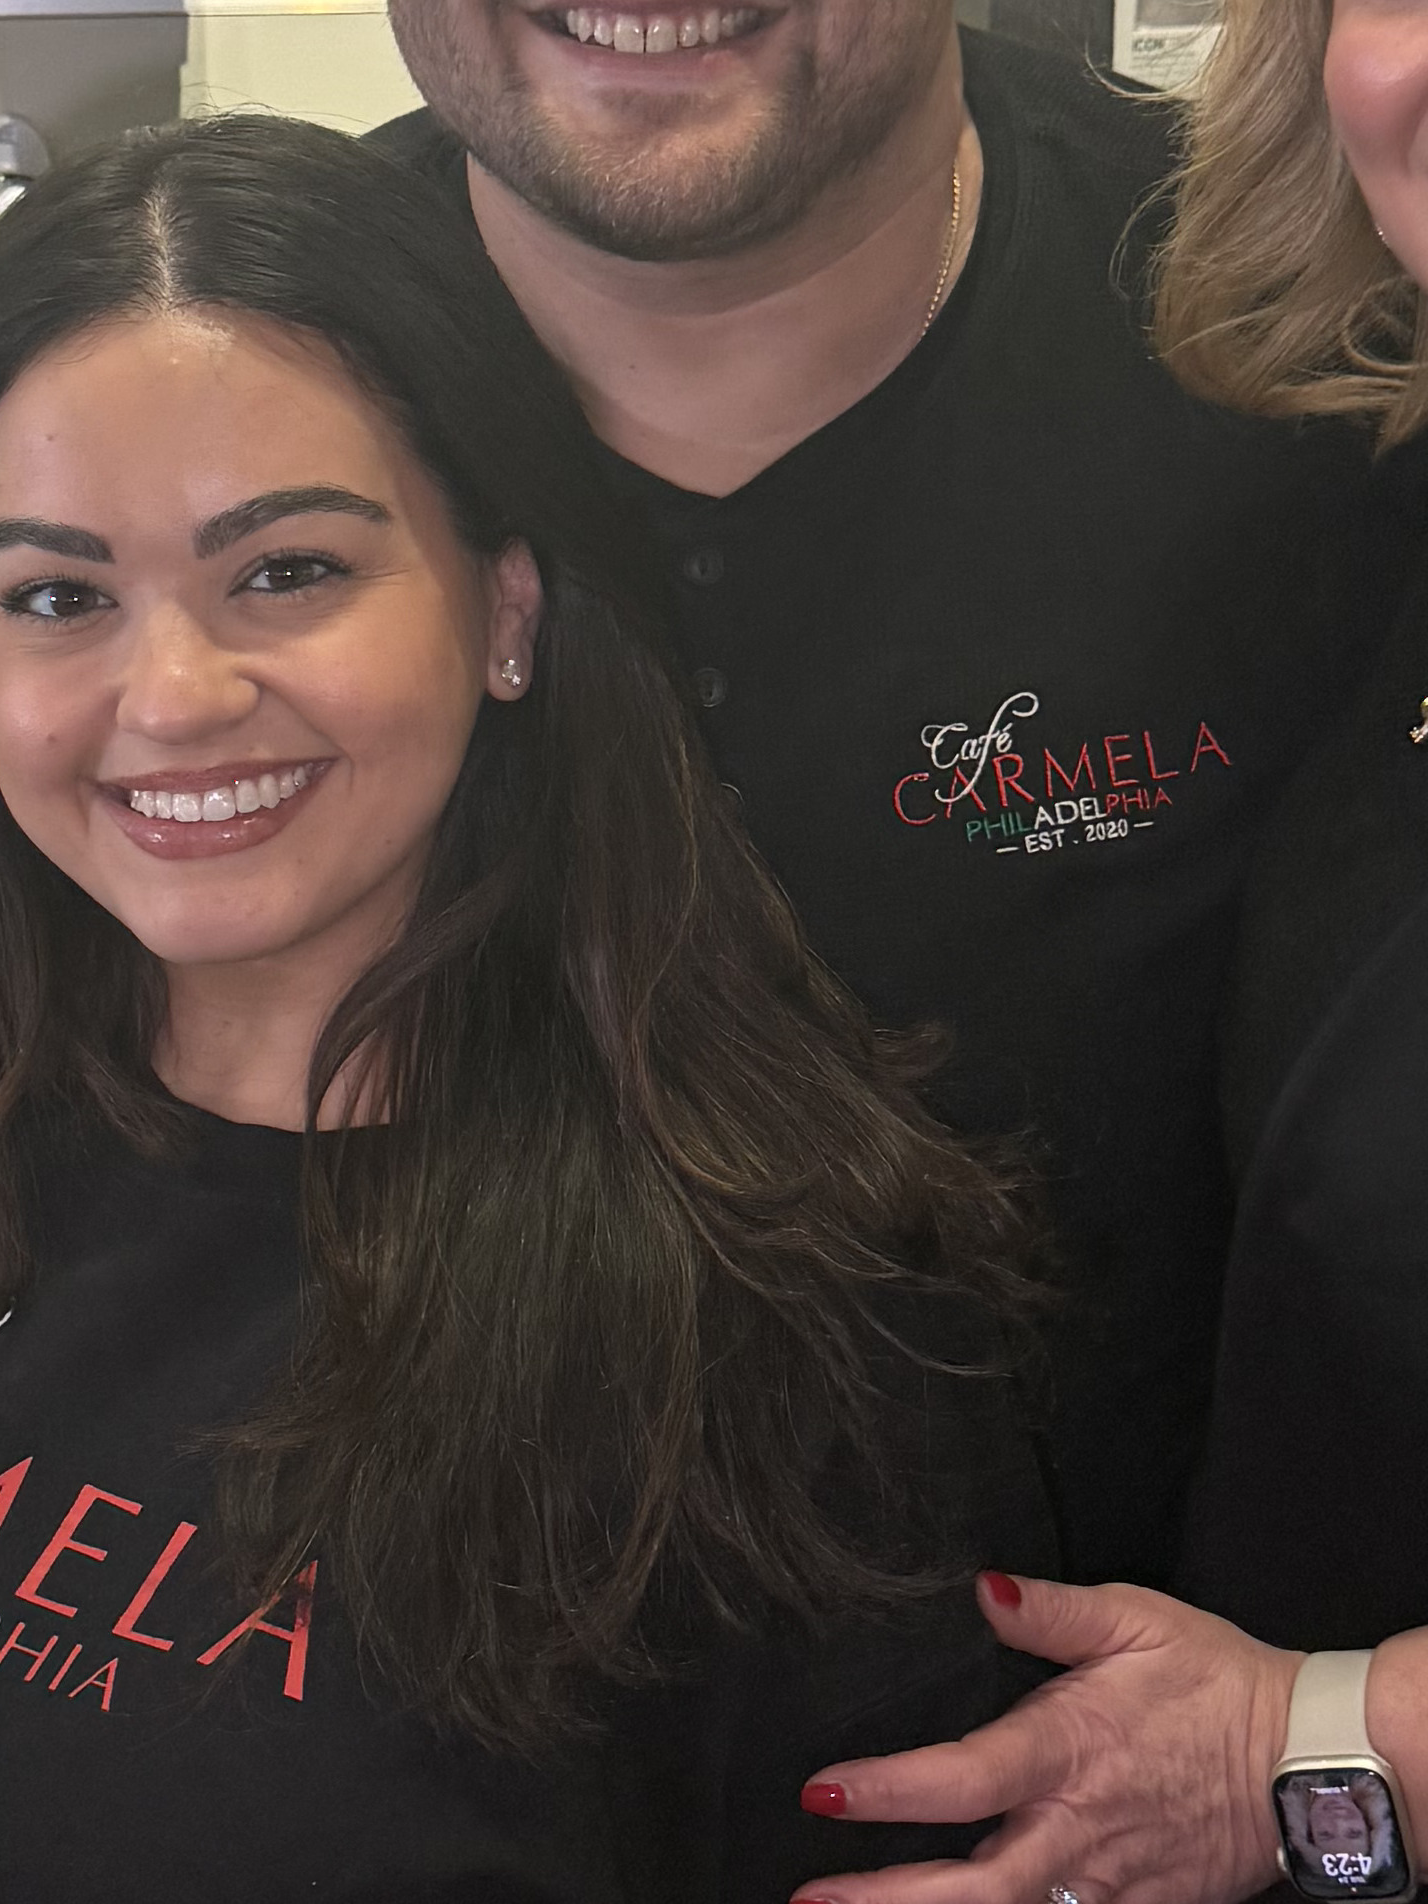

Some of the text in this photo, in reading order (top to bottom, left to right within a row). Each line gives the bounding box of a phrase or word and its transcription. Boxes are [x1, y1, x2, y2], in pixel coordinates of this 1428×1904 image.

[892, 721, 1233, 825] CARMELA
[921, 692, 1039, 803] Café
[966, 787, 1173, 842] PHILADELPHIA
[1085, 818, 1129, 842] 2020
[1322, 1853, 1372, 1877] 4:23
